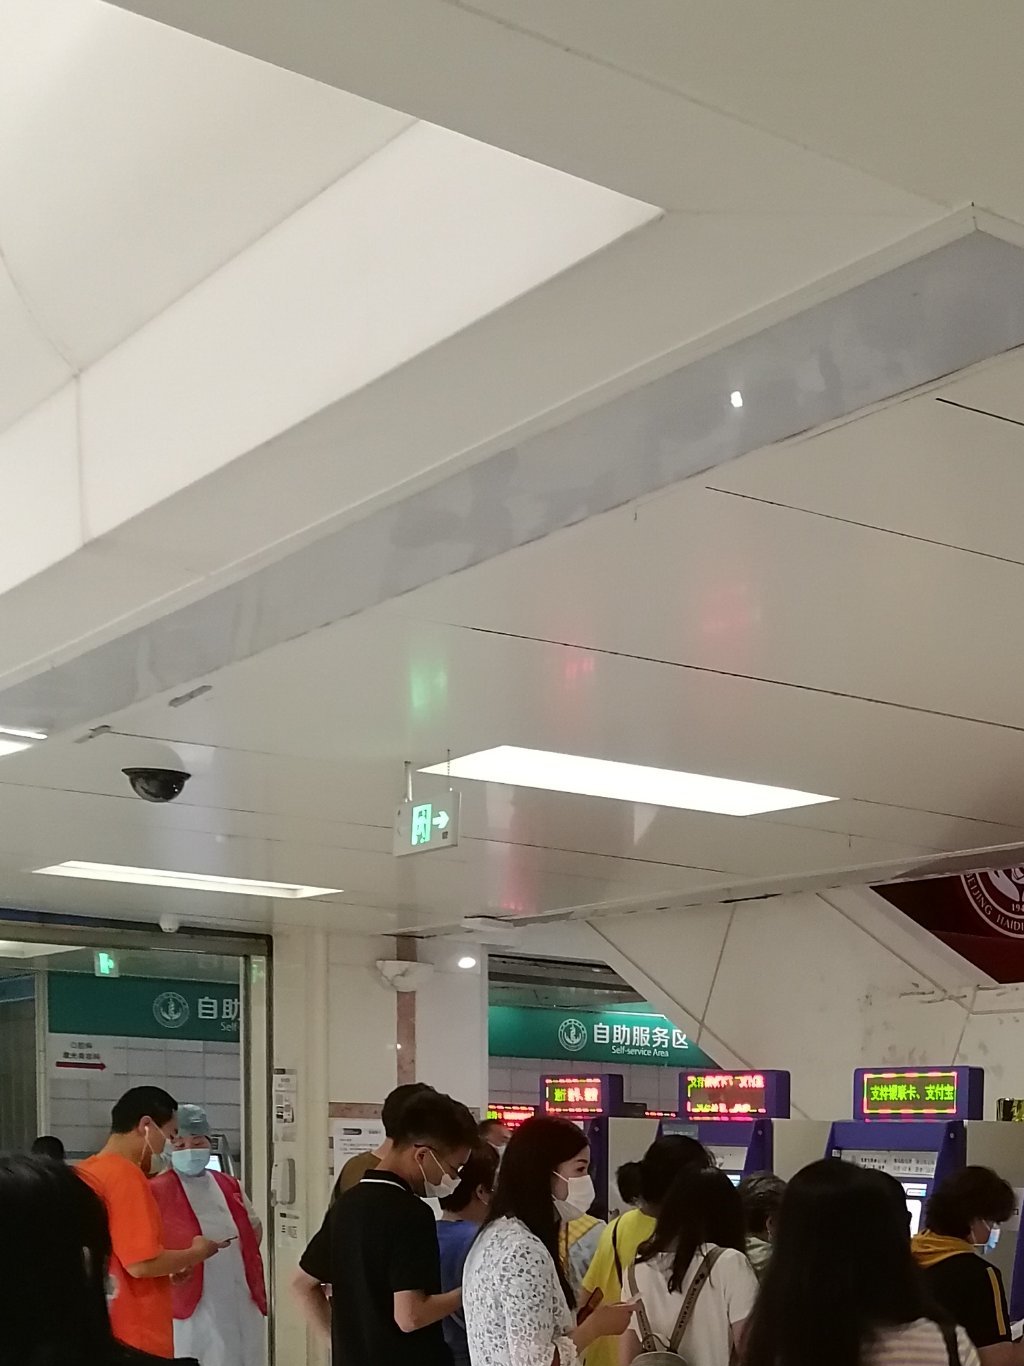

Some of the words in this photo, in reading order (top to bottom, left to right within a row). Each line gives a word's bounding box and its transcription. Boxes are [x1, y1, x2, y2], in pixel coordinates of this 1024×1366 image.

[593, 1023, 689, 1049] 自助服务区
[611, 1045, 652, 1057] Self-service
[653, 1048, 669, 1058] Area
[870, 1084, 954, 1101] 支持银联卡、支付宝
